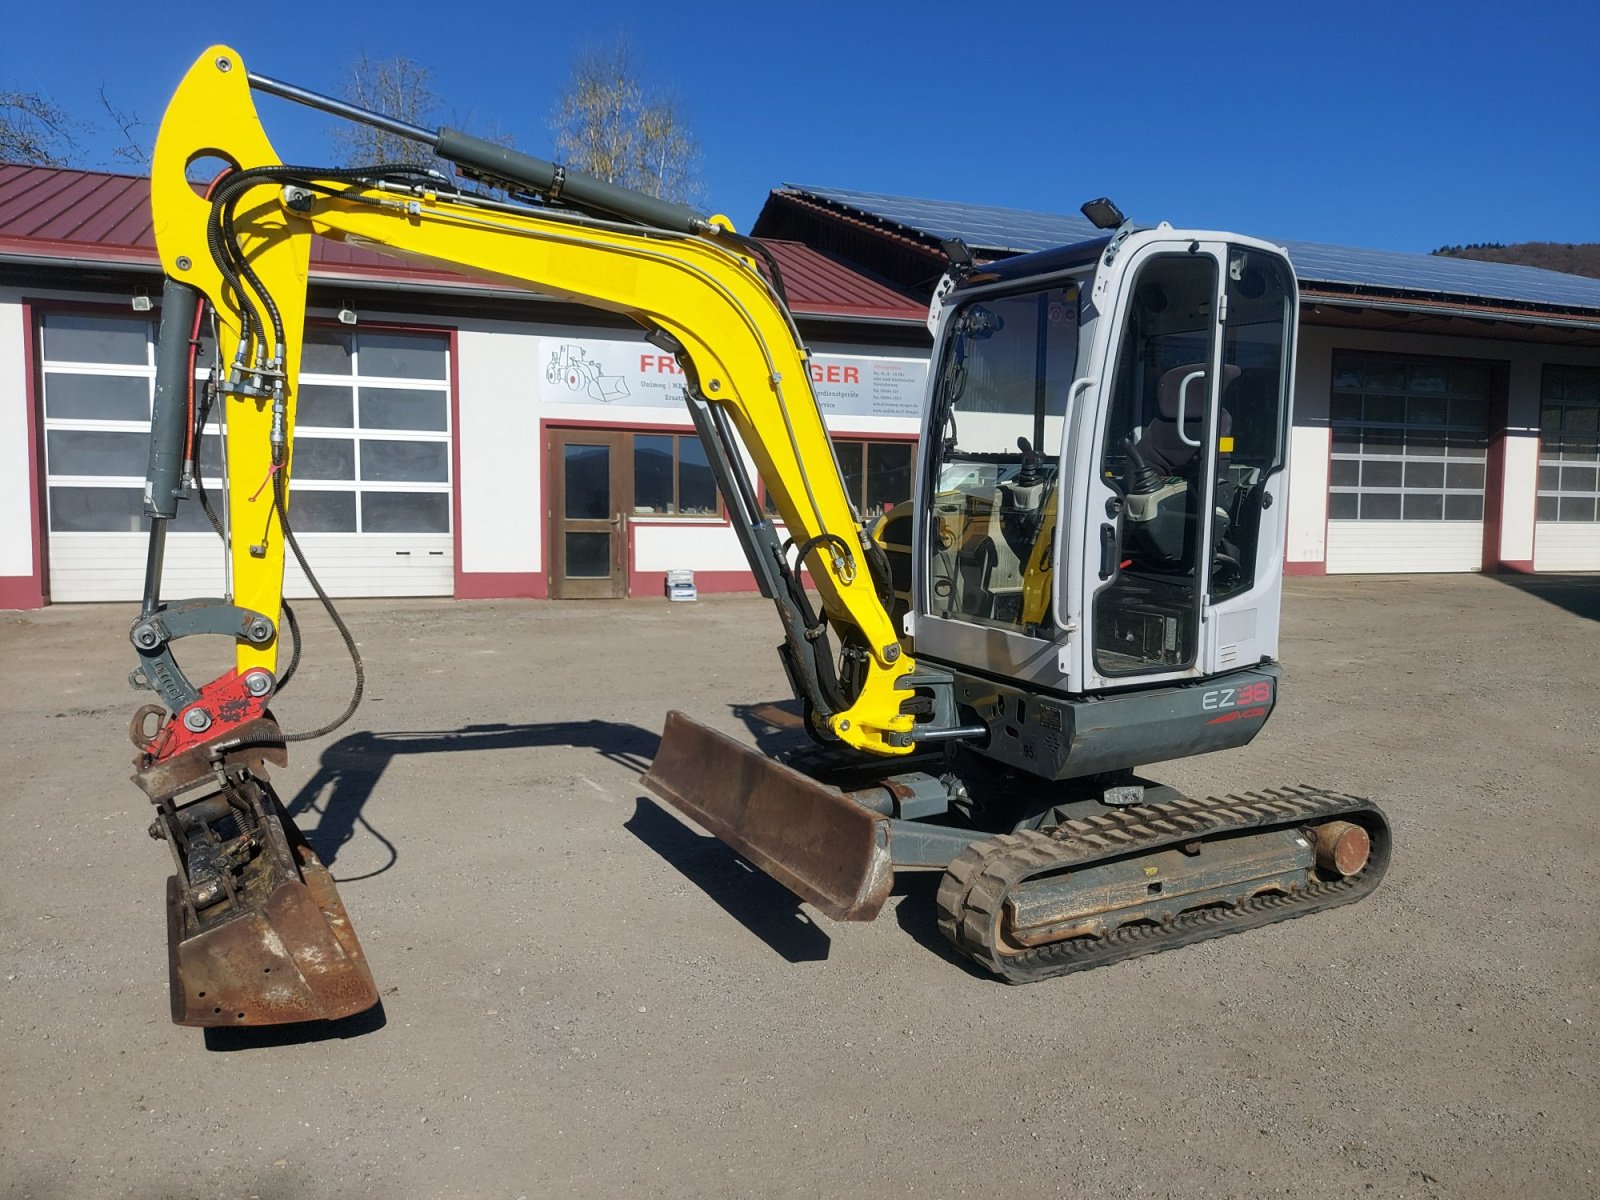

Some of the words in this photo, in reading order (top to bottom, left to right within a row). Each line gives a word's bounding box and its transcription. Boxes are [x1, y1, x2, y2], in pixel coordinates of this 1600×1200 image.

[640, 354, 684, 375] FR
[810, 364, 859, 384] GER
[640, 381, 667, 390] Unimog
[816, 390, 859, 399] erdienstgeräte
